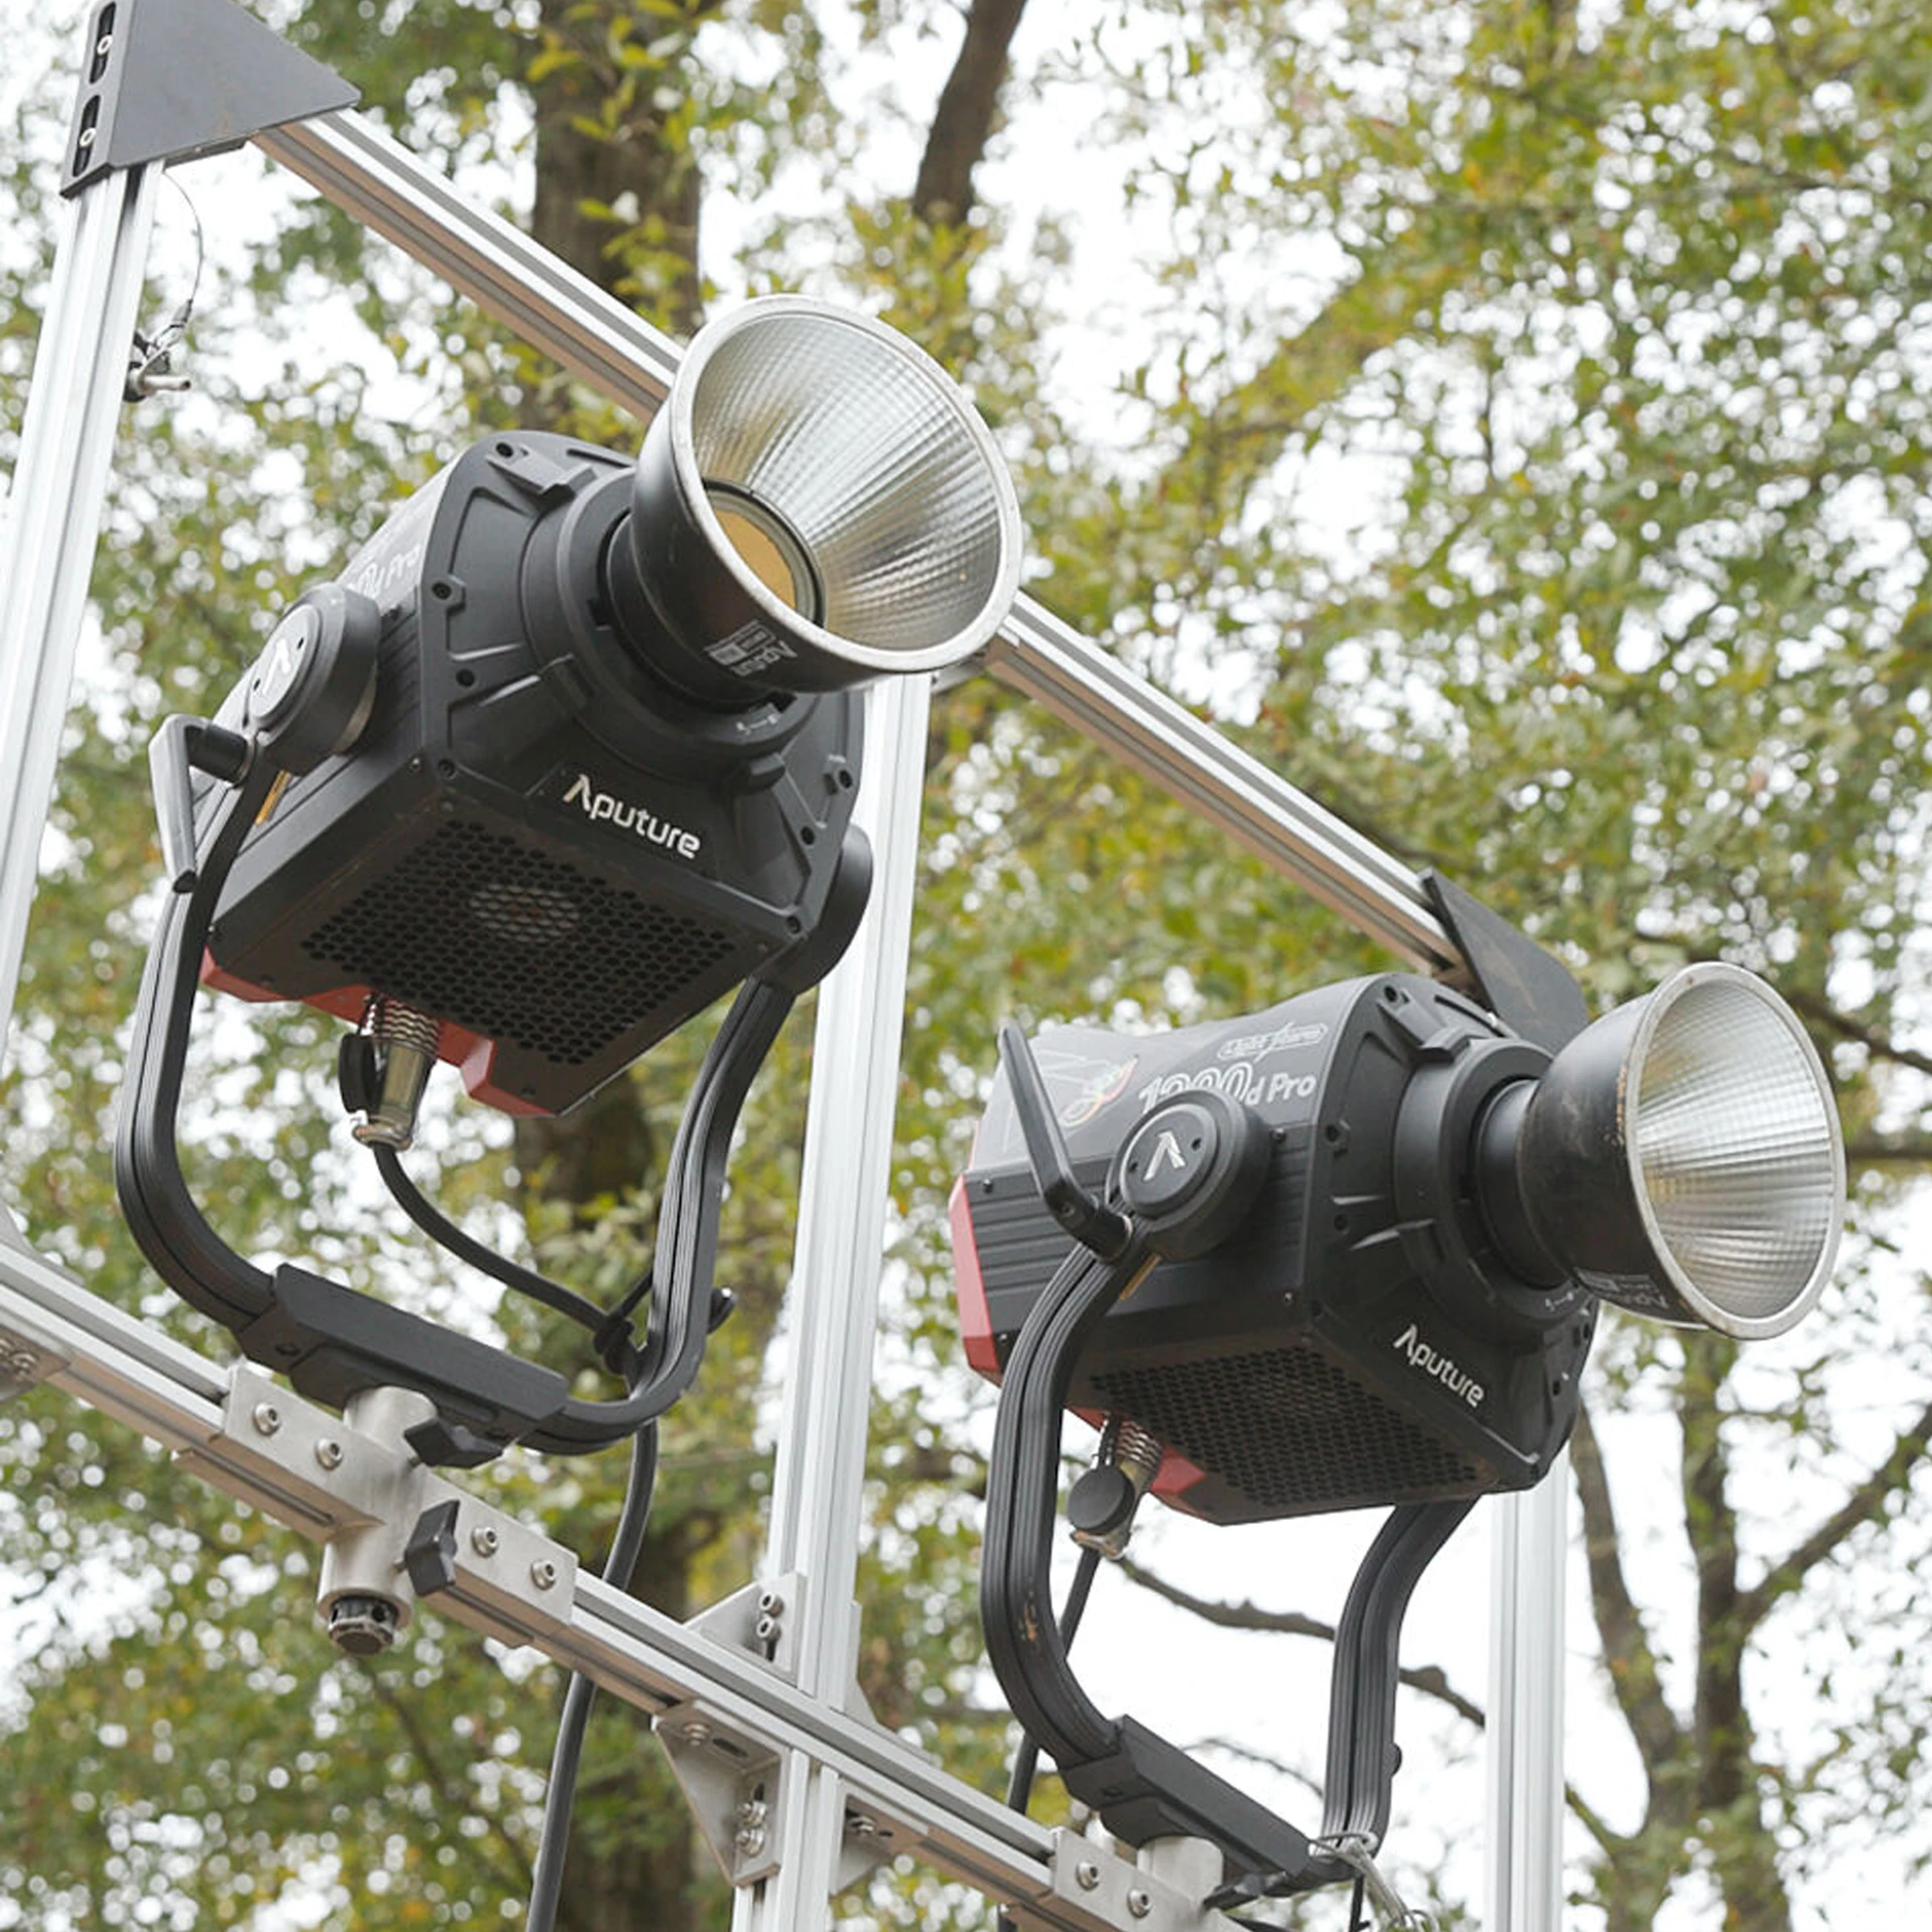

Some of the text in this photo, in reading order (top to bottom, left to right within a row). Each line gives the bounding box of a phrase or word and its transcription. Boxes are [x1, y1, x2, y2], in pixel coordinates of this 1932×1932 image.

[563, 773, 700, 859] Aputure
[1266, 1073, 1317, 1103] Pro
[1393, 1324, 1484, 1408] Aputure
